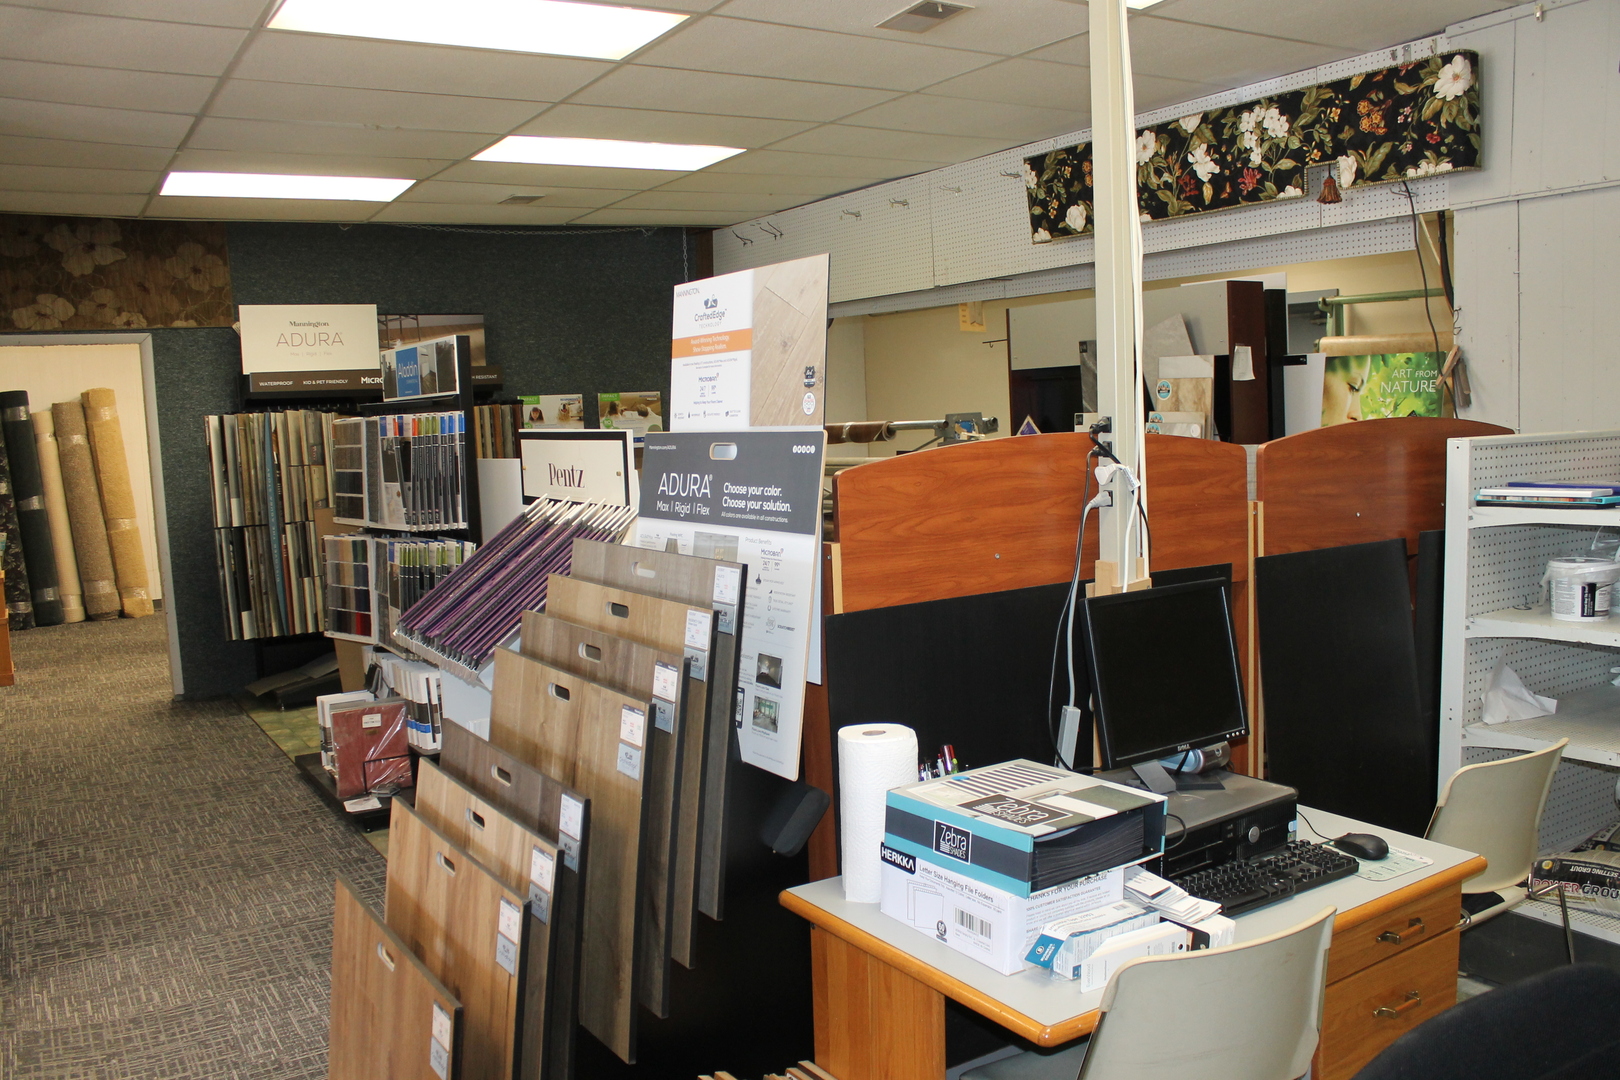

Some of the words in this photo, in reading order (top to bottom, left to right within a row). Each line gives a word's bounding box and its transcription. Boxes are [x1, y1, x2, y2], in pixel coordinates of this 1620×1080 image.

[1391, 368, 1413, 379] ART
[1415, 369, 1438, 378] FROM
[1380, 379, 1437, 394] NATURE
[548, 462, 586, 489] Pentz
[723, 482, 747, 495] Choose
[747, 485, 764, 498] your
[764, 484, 783, 497] color.
[656, 500, 670, 512] Max
[674, 501, 691, 517] Rigid
[696, 504, 711, 516] Flex
[722, 496, 747, 509] Choose
[746, 499, 763, 512] your
[763, 499, 792, 513] solution.
[1177, 744, 1191, 752] DELL
[985, 797, 1050, 821] Zebra
[939, 825, 967, 850] Zebra
[881, 846, 915, 872] HERKKA
[949, 847, 967, 859] SHADES
[1570, 865, 1590, 874] GROUT
[919, 864, 933, 876] Letter
[933, 870, 944, 881] Size
[944, 875, 965, 892] Hanging
[964, 884, 974, 894] File
[974, 888, 994, 903] Folders
[1026, 891, 1050, 902] THANKS
[1051, 888, 1063, 896] FOR
[1063, 882, 1079, 892] YOUR
[1079, 874, 1108, 888] PURCHASE
